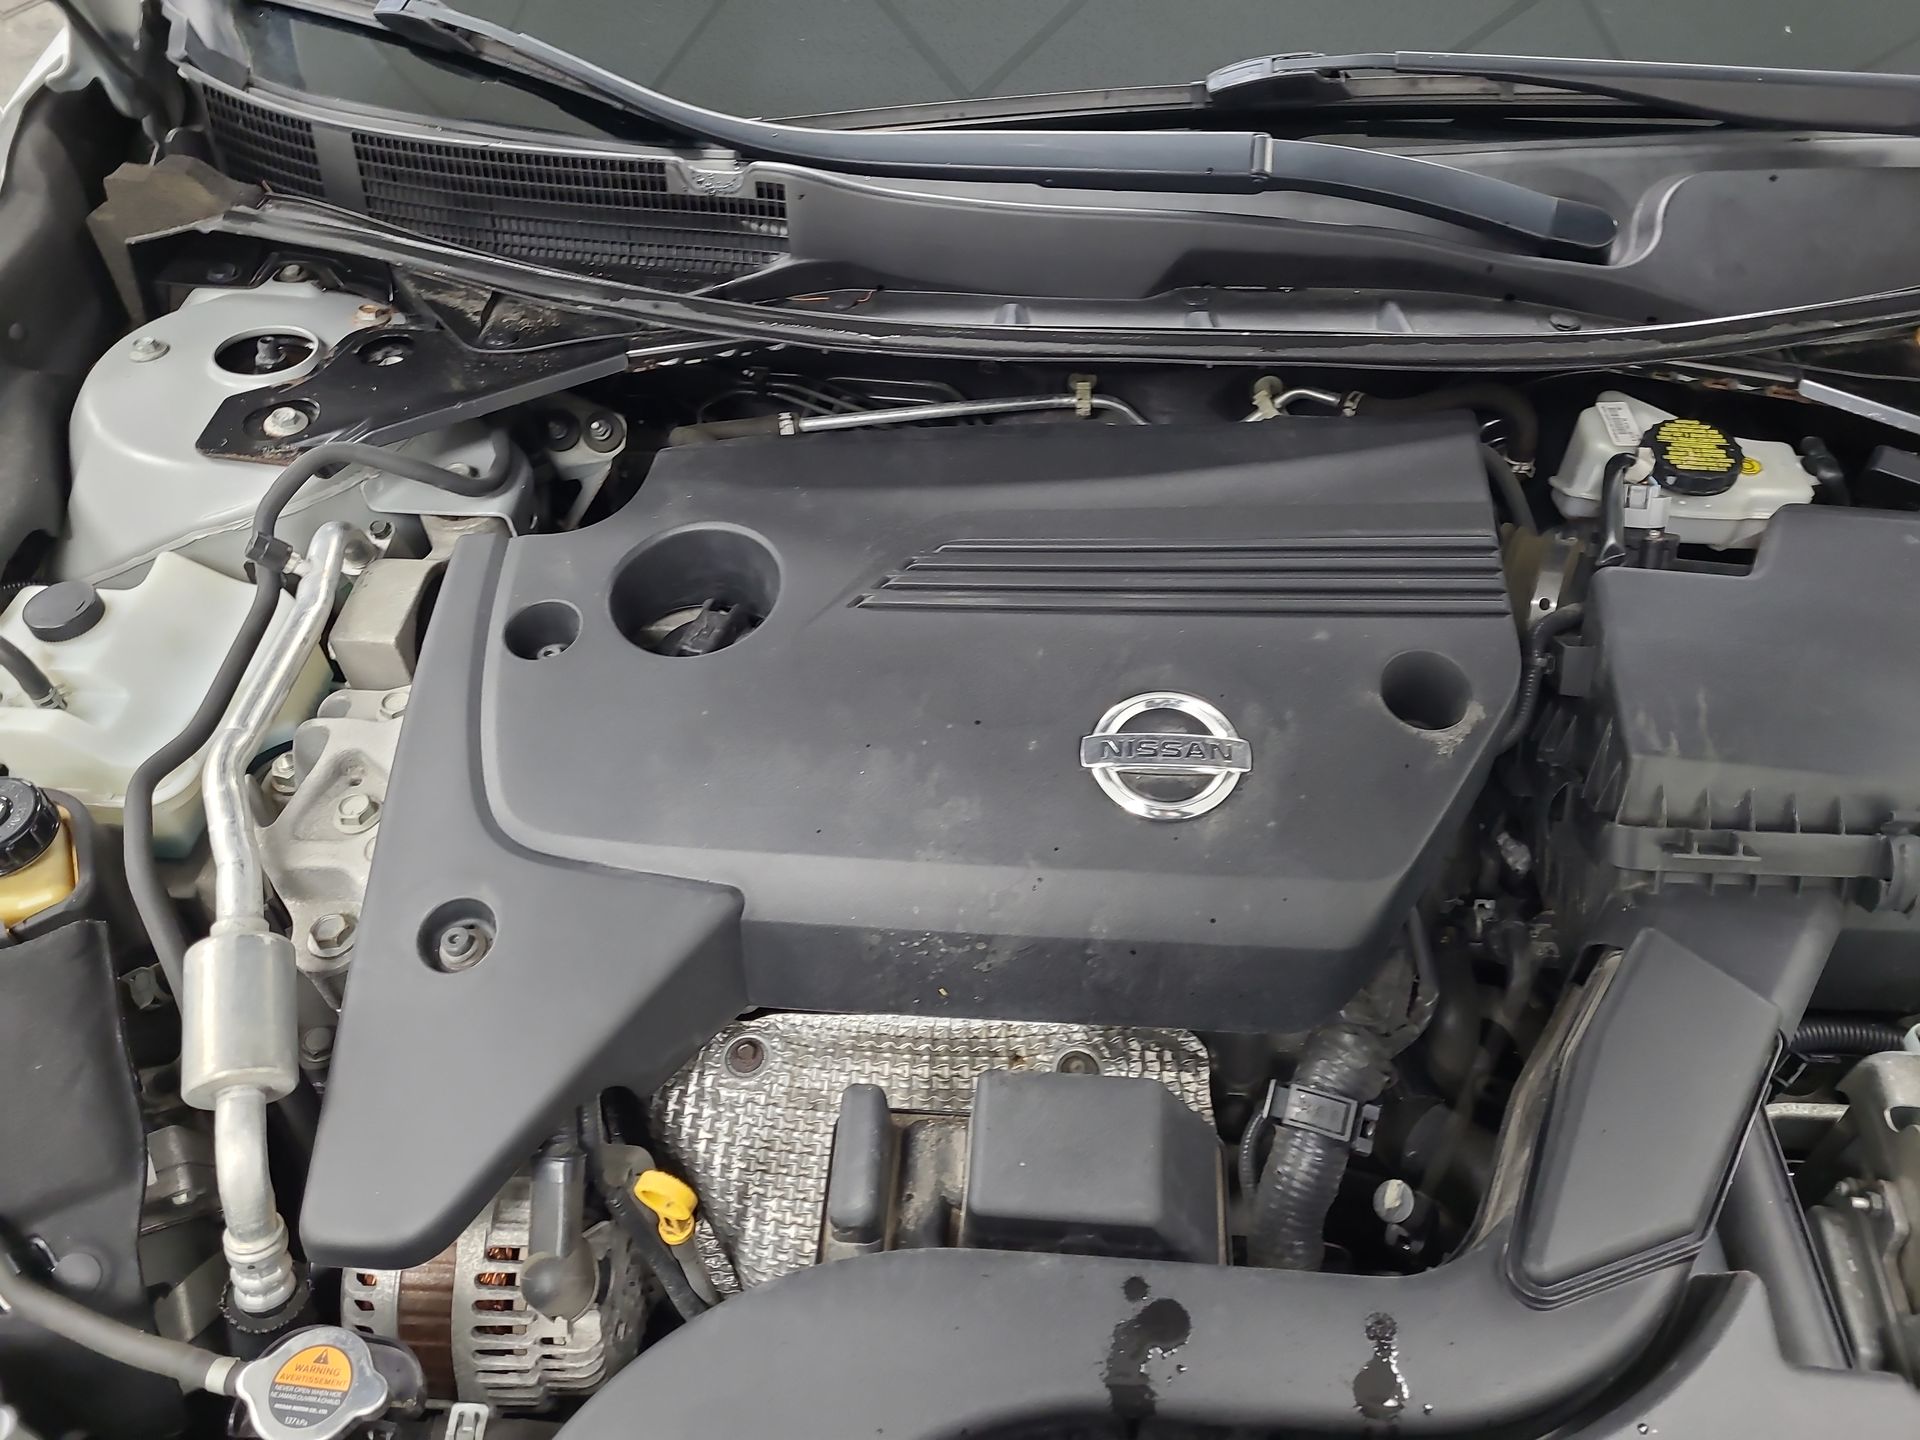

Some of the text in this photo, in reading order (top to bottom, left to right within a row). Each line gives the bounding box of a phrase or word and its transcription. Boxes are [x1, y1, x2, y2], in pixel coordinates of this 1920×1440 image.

[1100, 739, 1233, 763] NISSAN
[295, 1363, 341, 1377] WARNING
[279, 1373, 347, 1387] AVERTISSEMENT
[274, 1384, 294, 1392] NEVER
